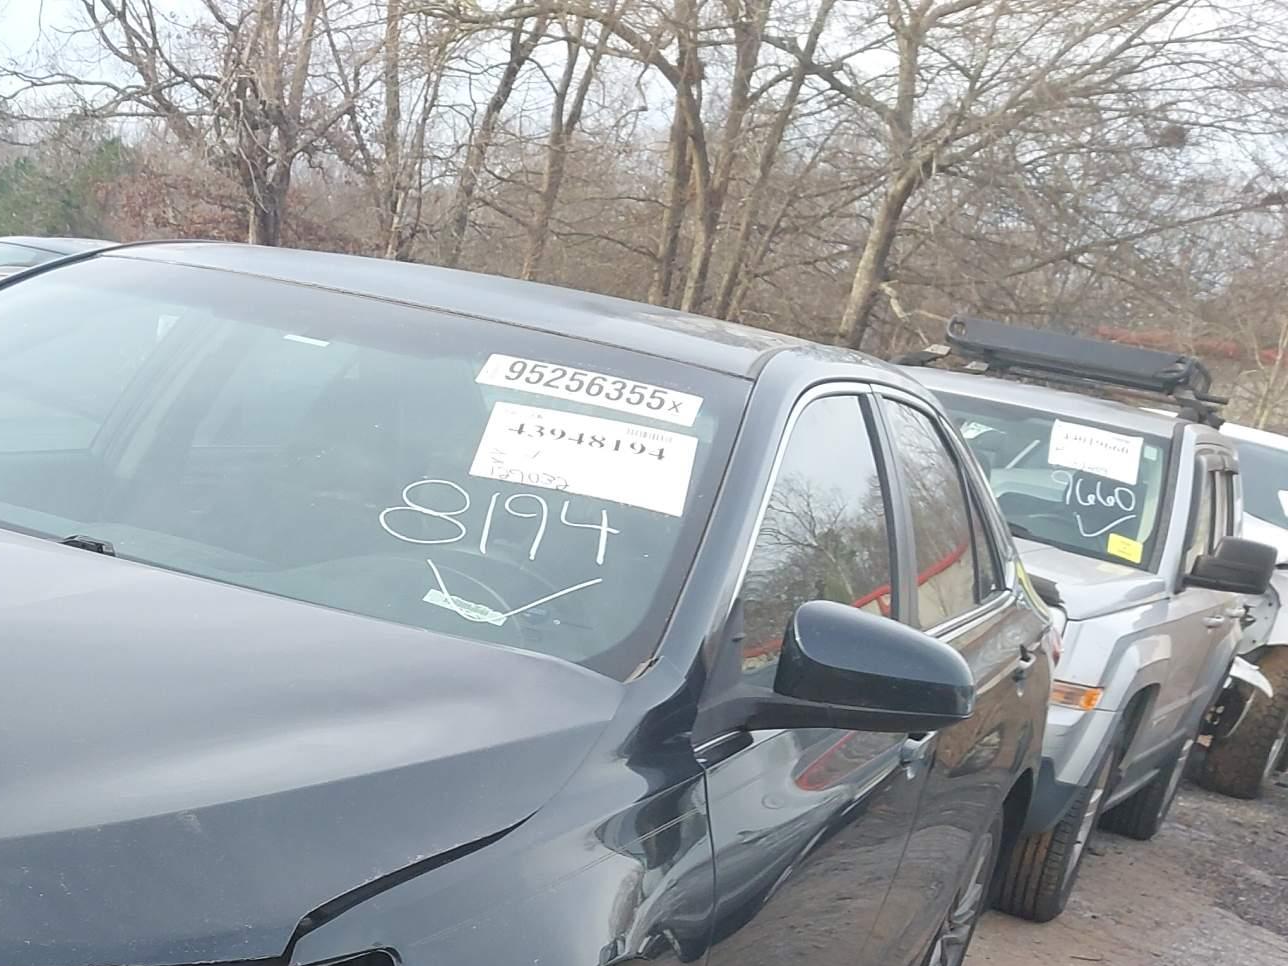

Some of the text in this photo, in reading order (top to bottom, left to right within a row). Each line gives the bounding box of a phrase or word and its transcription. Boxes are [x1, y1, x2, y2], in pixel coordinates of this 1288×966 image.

[508, 423, 665, 461] 43948194
[1051, 470, 1136, 512] 9660
[379, 479, 620, 566] 8194
